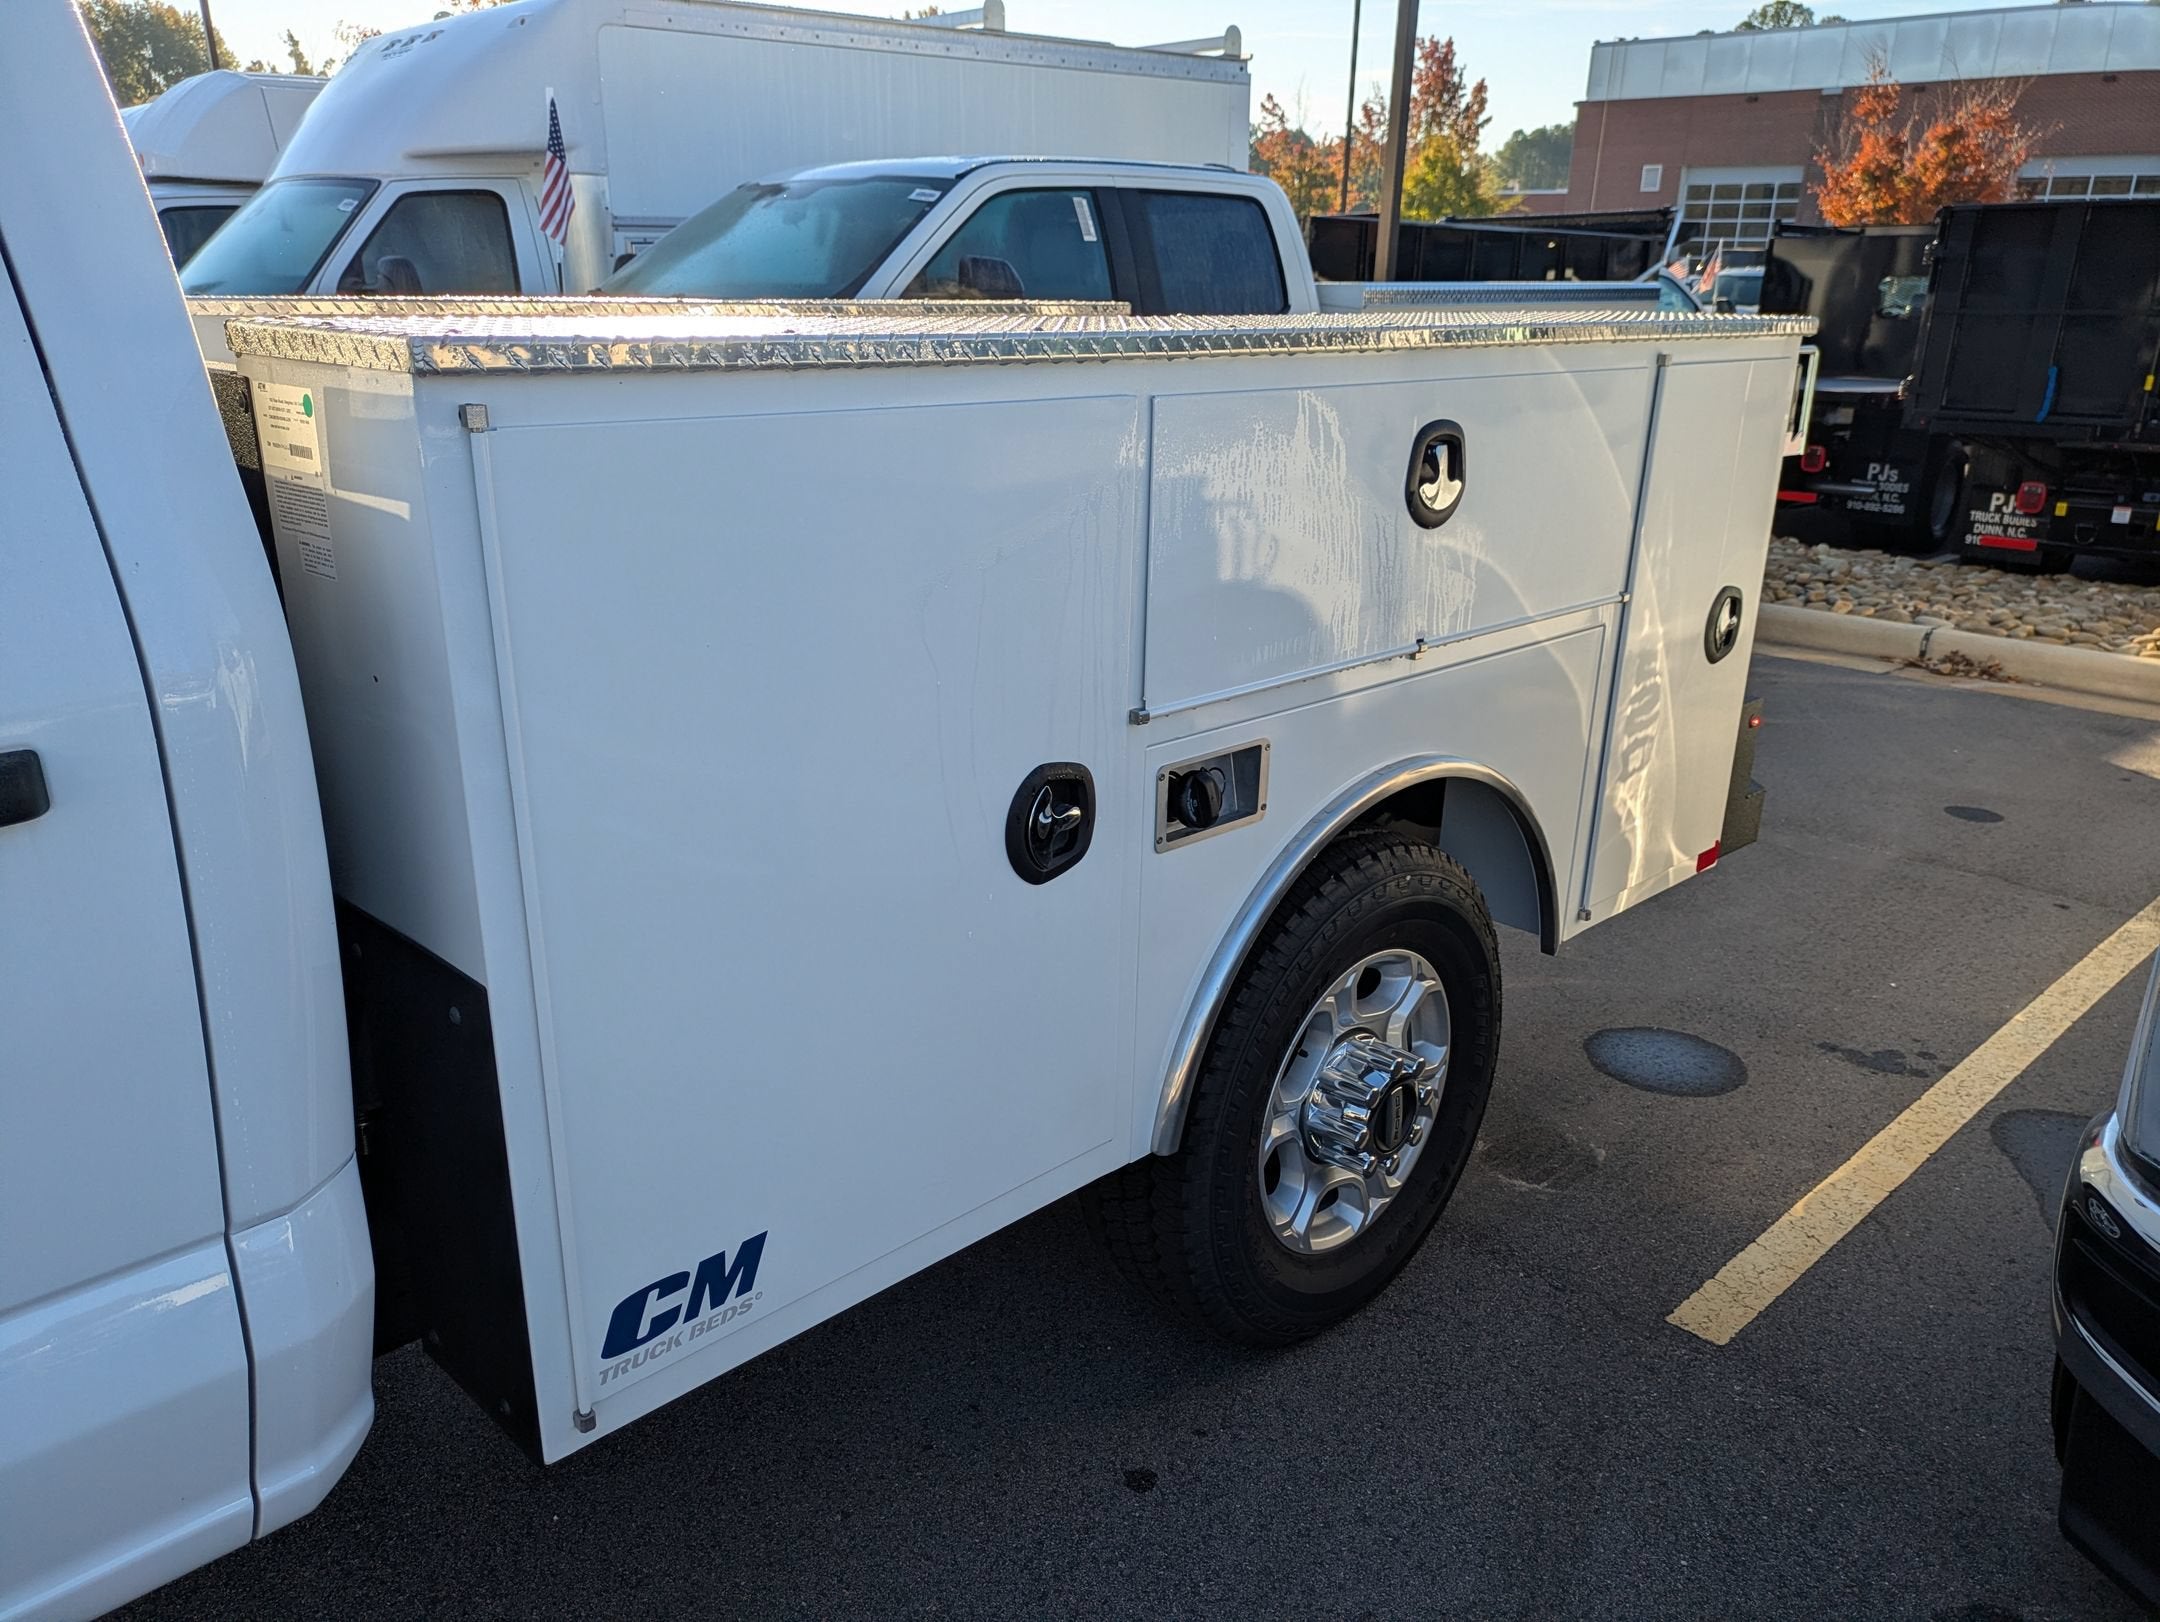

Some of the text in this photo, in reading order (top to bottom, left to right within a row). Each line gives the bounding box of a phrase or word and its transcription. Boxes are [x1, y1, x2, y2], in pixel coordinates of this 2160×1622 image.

[1866, 462, 1899, 483] PJs
[1989, 491, 2024, 515] PJ
[1969, 509, 2002, 524] TRUCK
[2006, 526, 2028, 539] N.C.
[600, 1230, 769, 1360] CM
[599, 1330, 684, 1386] TRUCK
